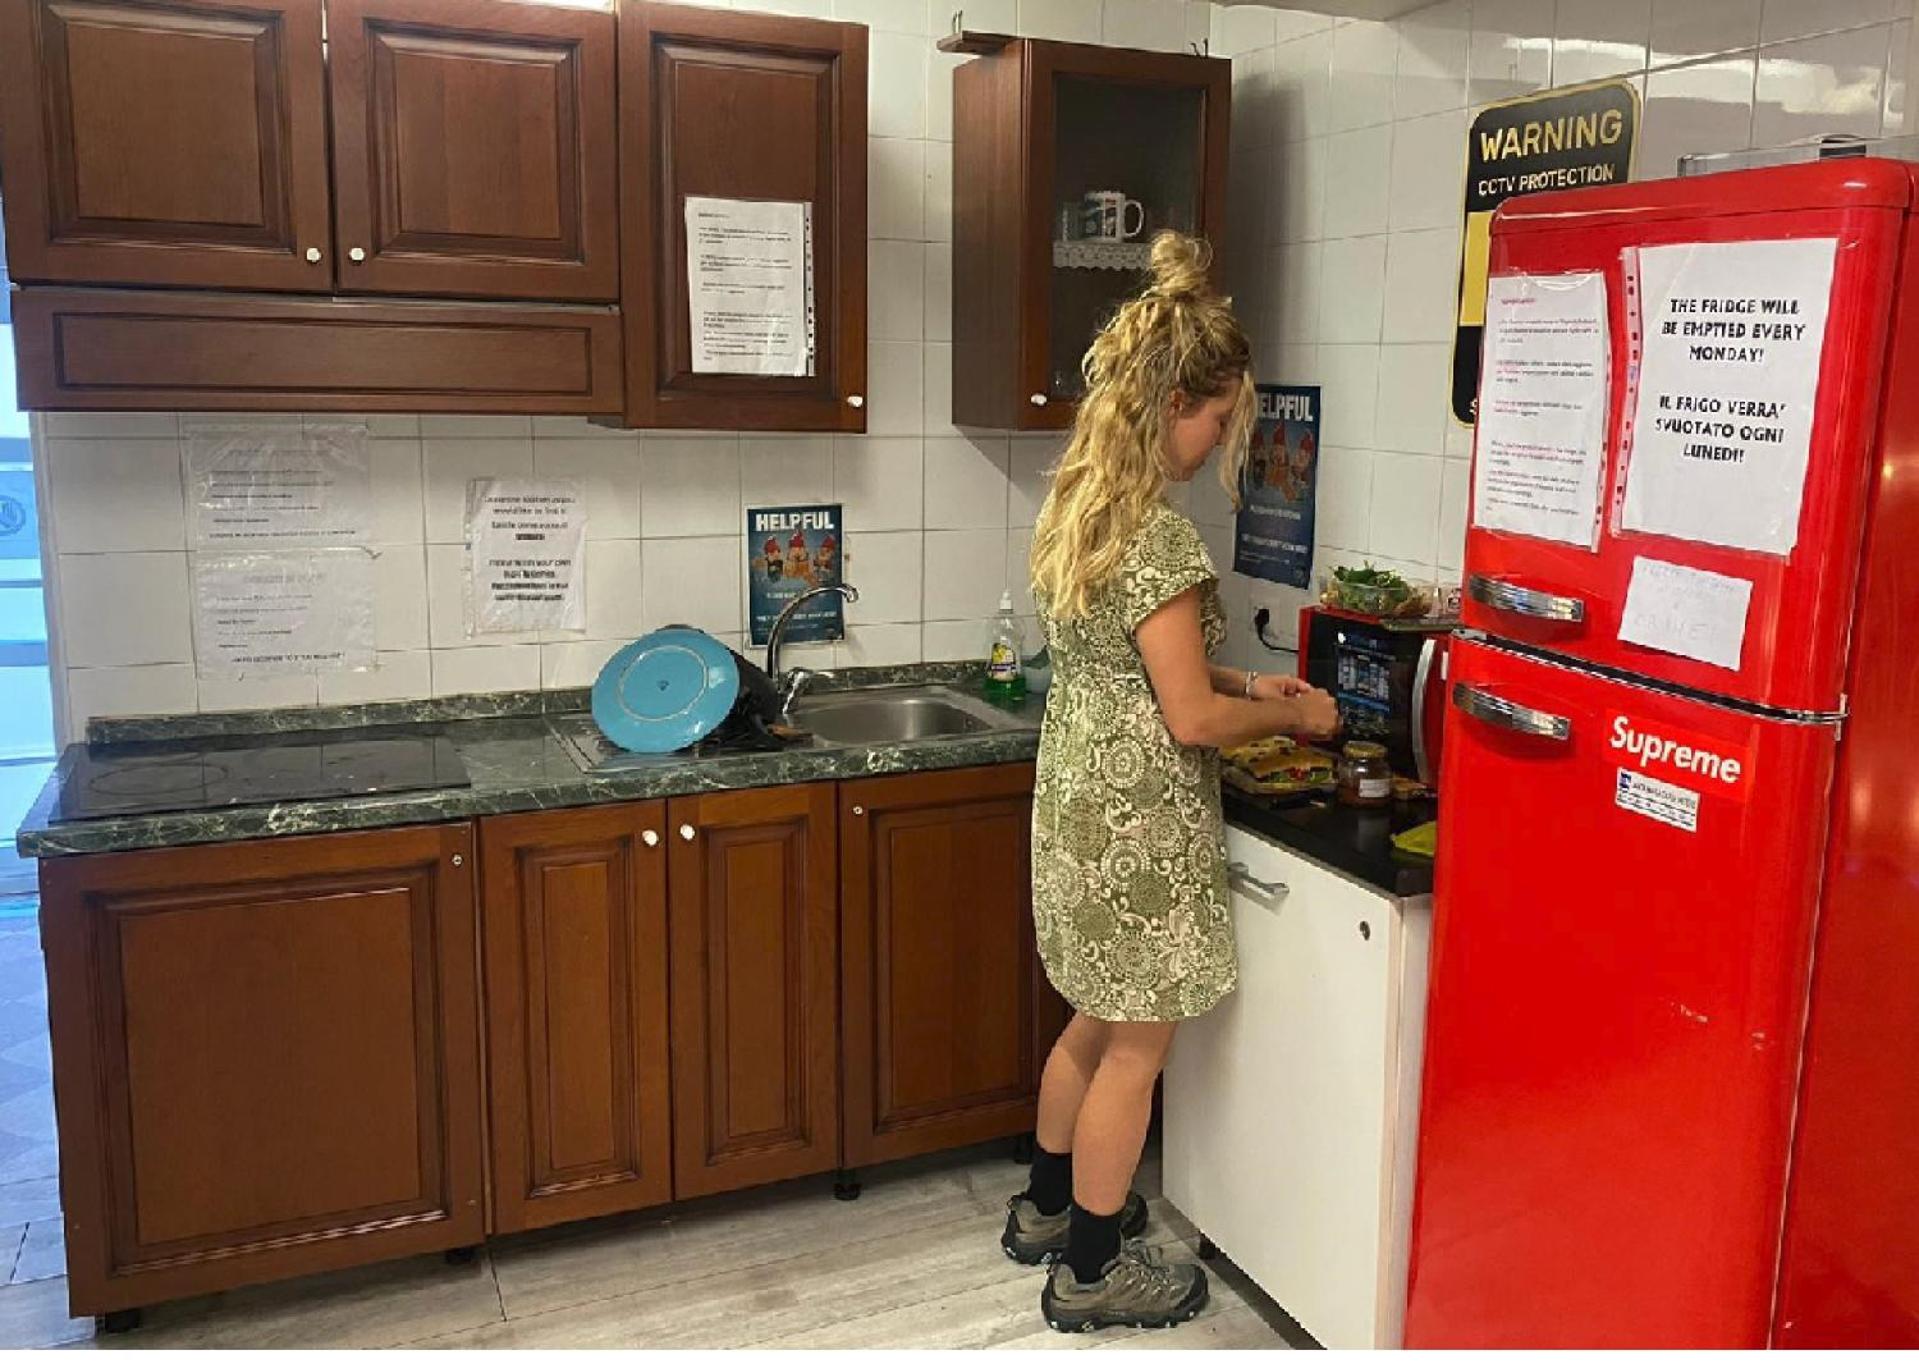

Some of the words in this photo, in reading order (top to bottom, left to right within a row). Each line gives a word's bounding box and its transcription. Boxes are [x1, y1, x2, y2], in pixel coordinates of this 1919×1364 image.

[1480, 109, 1622, 162] WARNING
[1478, 176, 1515, 196] CCTV
[1519, 163, 1615, 191] PROTECTION
[1670, 299, 1697, 313] THE
[1701, 299, 1756, 314] FRIDGE
[1761, 299, 1800, 315] WILL
[1662, 321, 1678, 335] BE
[1683, 321, 1746, 339] EMPTIED
[1752, 323, 1806, 341] EVERY
[1689, 345, 1764, 362] MONDAY!
[1257, 392, 1313, 421] ELPFUL
[1659, 395, 1671, 409] IL
[1676, 396, 1721, 412] FRIGO
[1728, 401, 1786, 419] VERRA'
[1655, 418, 1735, 438] SVUOTATO
[1740, 426, 1784, 443] OGNI
[755, 511, 834, 532] HELPFUL
[1609, 715, 1742, 784] Supreme
